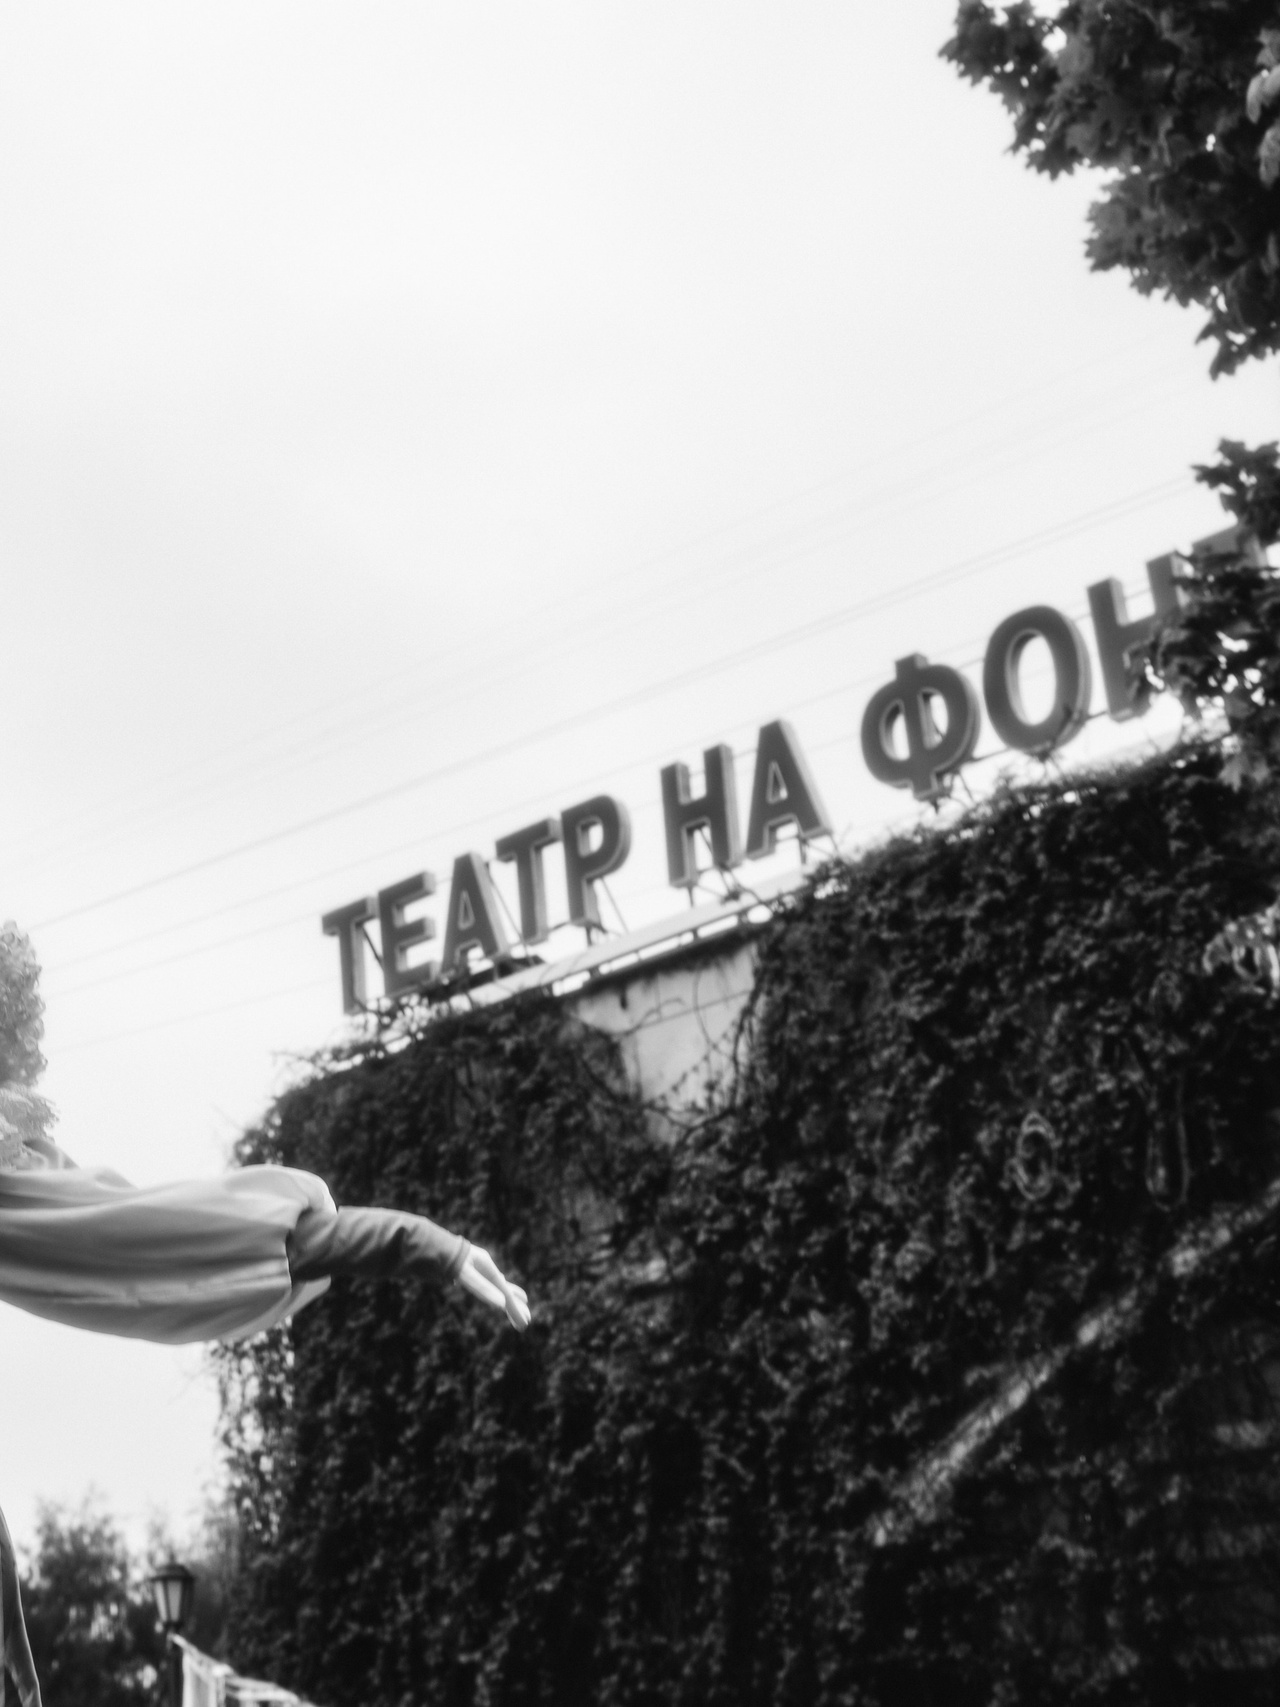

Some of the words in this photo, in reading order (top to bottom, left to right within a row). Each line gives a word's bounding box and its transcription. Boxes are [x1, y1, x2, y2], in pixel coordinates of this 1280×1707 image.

[321, 794, 632, 1016] ТЕАТР
[660, 719, 832, 888] НА
[860, 520, 1268, 802] ФОН
